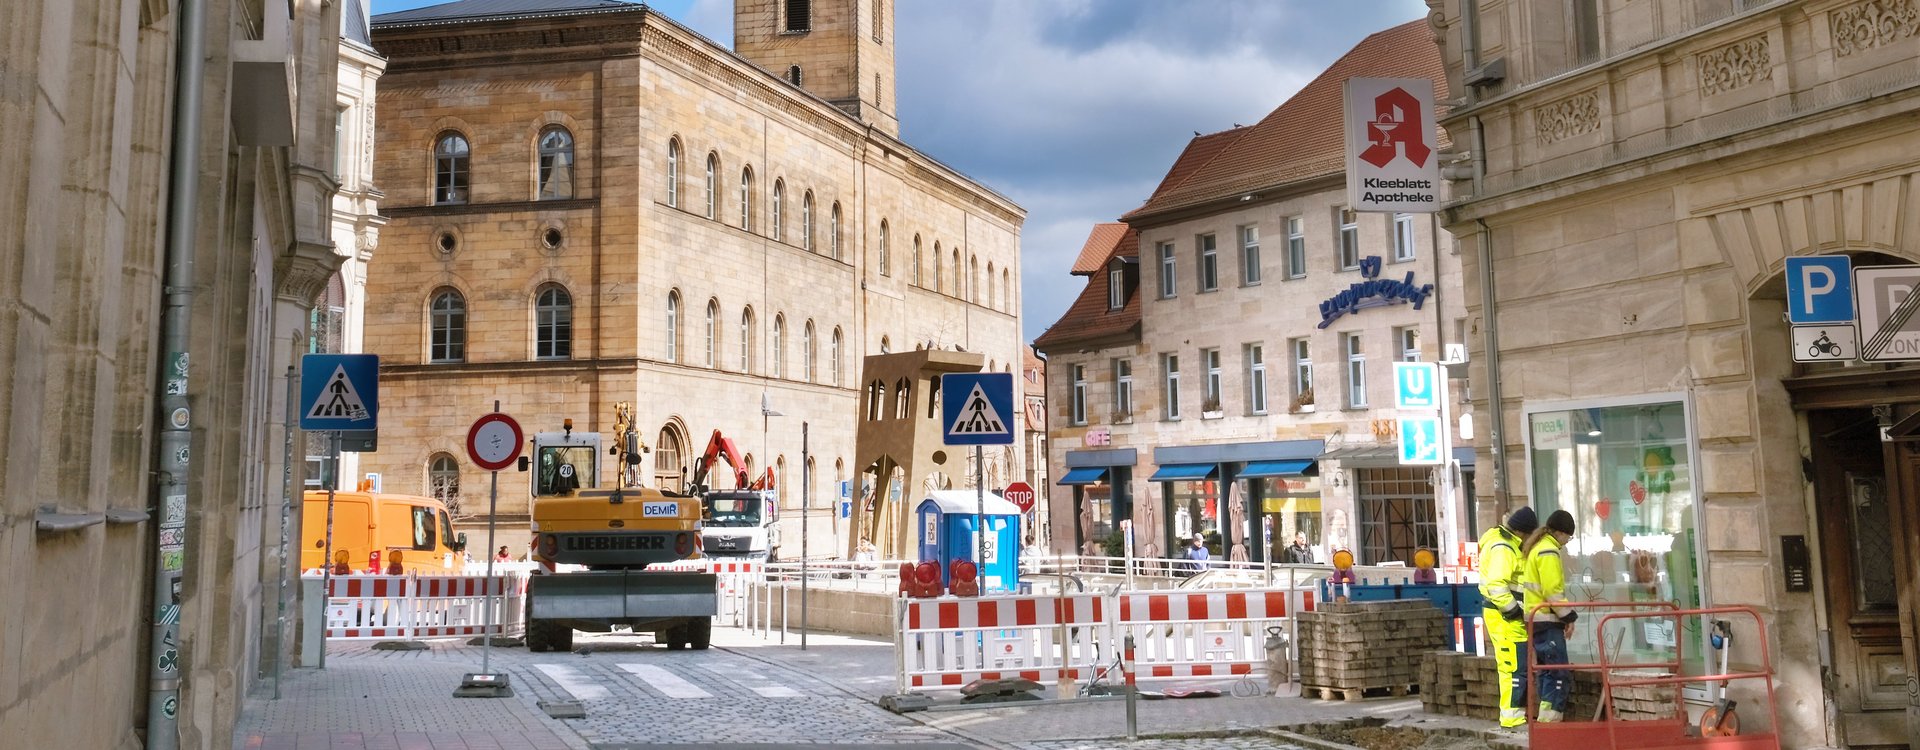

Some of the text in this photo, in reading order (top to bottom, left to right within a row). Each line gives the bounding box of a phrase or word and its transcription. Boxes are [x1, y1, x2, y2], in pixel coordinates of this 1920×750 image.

[1364, 177, 1431, 189] Kleeblatt
[1362, 191, 1434, 204] Apotheke
[1801, 265, 1836, 314] P
[1885, 339, 1920, 354] ZON
[1451, 347, 1461, 361] A
[1406, 368, 1425, 395] U
[561, 465, 572, 476] 20
[1006, 491, 1033, 505] STOP
[644, 503, 677, 515] DEMIR
[567, 535, 665, 551] LIEBHERR
